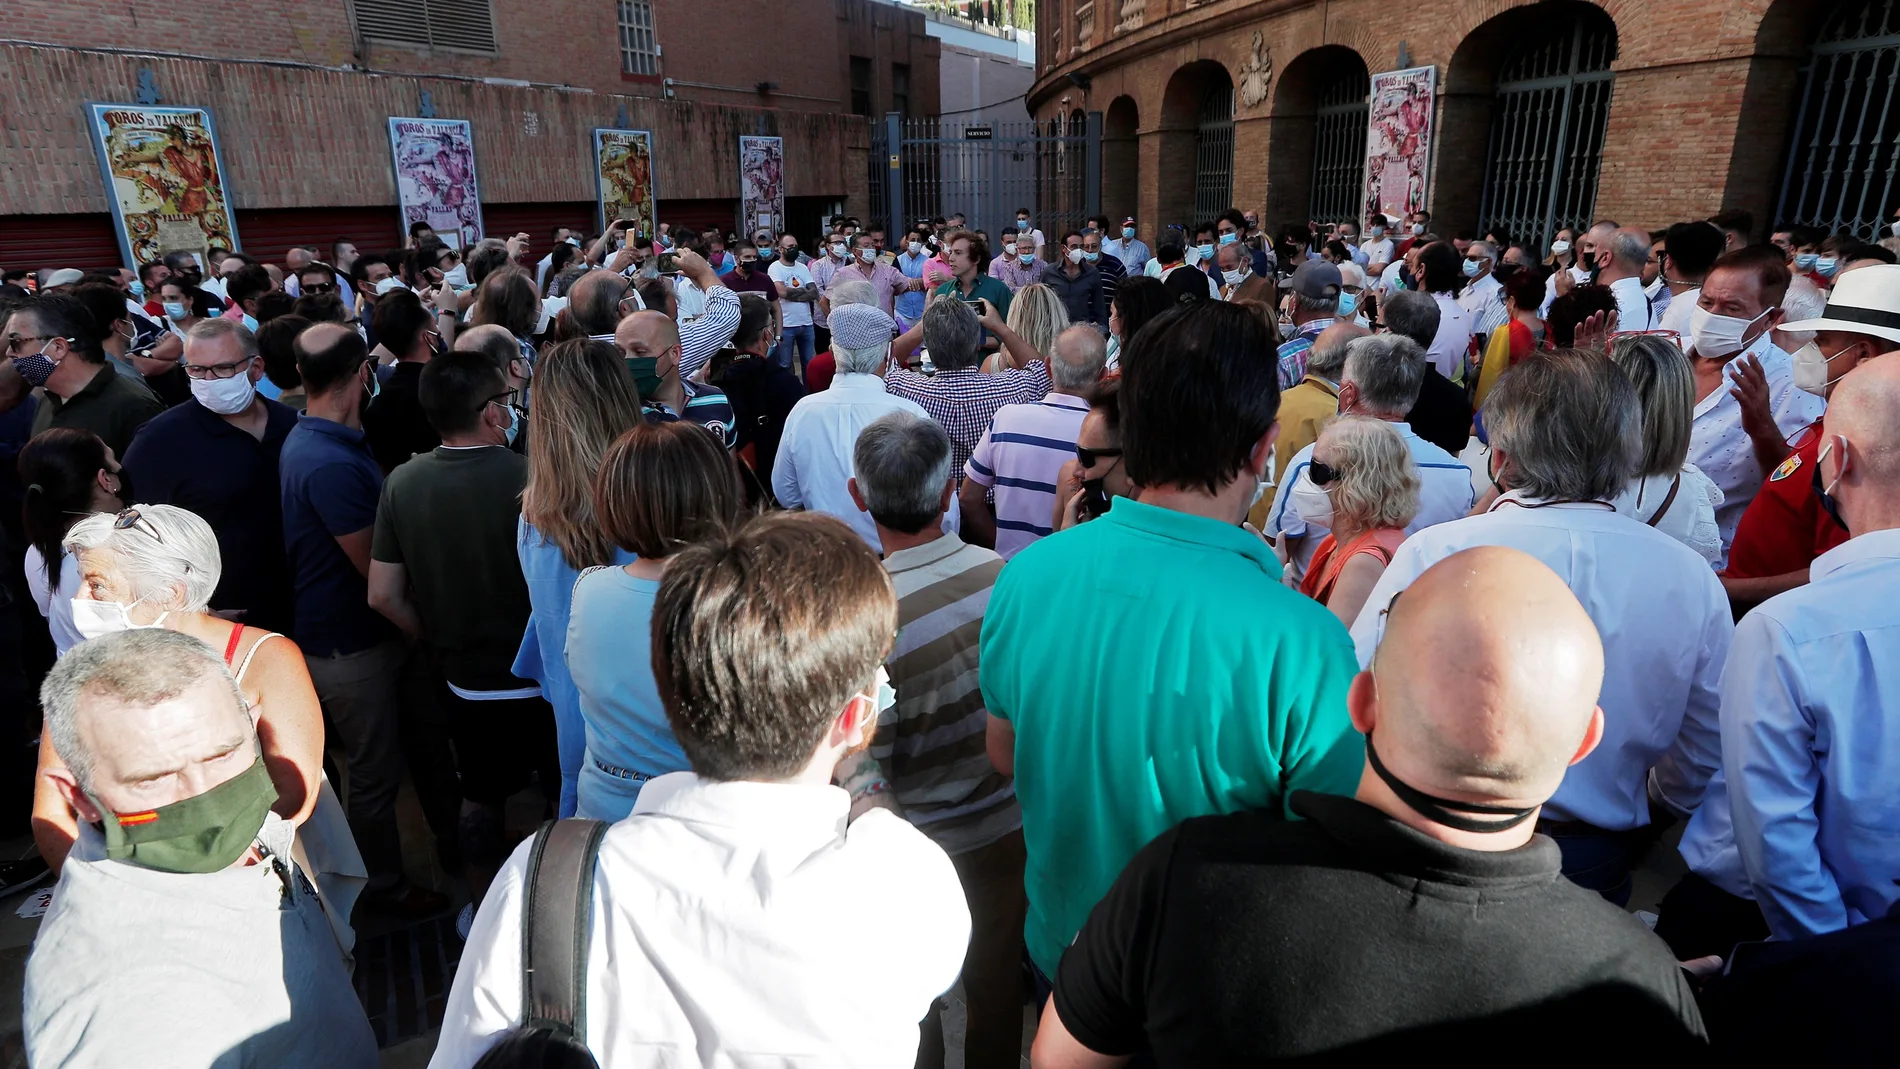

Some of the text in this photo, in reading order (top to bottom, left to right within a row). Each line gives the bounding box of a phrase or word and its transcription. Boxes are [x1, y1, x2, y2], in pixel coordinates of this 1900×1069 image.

[109, 111, 145, 128] TOROS
[154, 112, 201, 127] VALENCIA
[399, 122, 424, 136] TOROS
[431, 205, 453, 213] FALLAS
[161, 213, 192, 222] FALLAS
